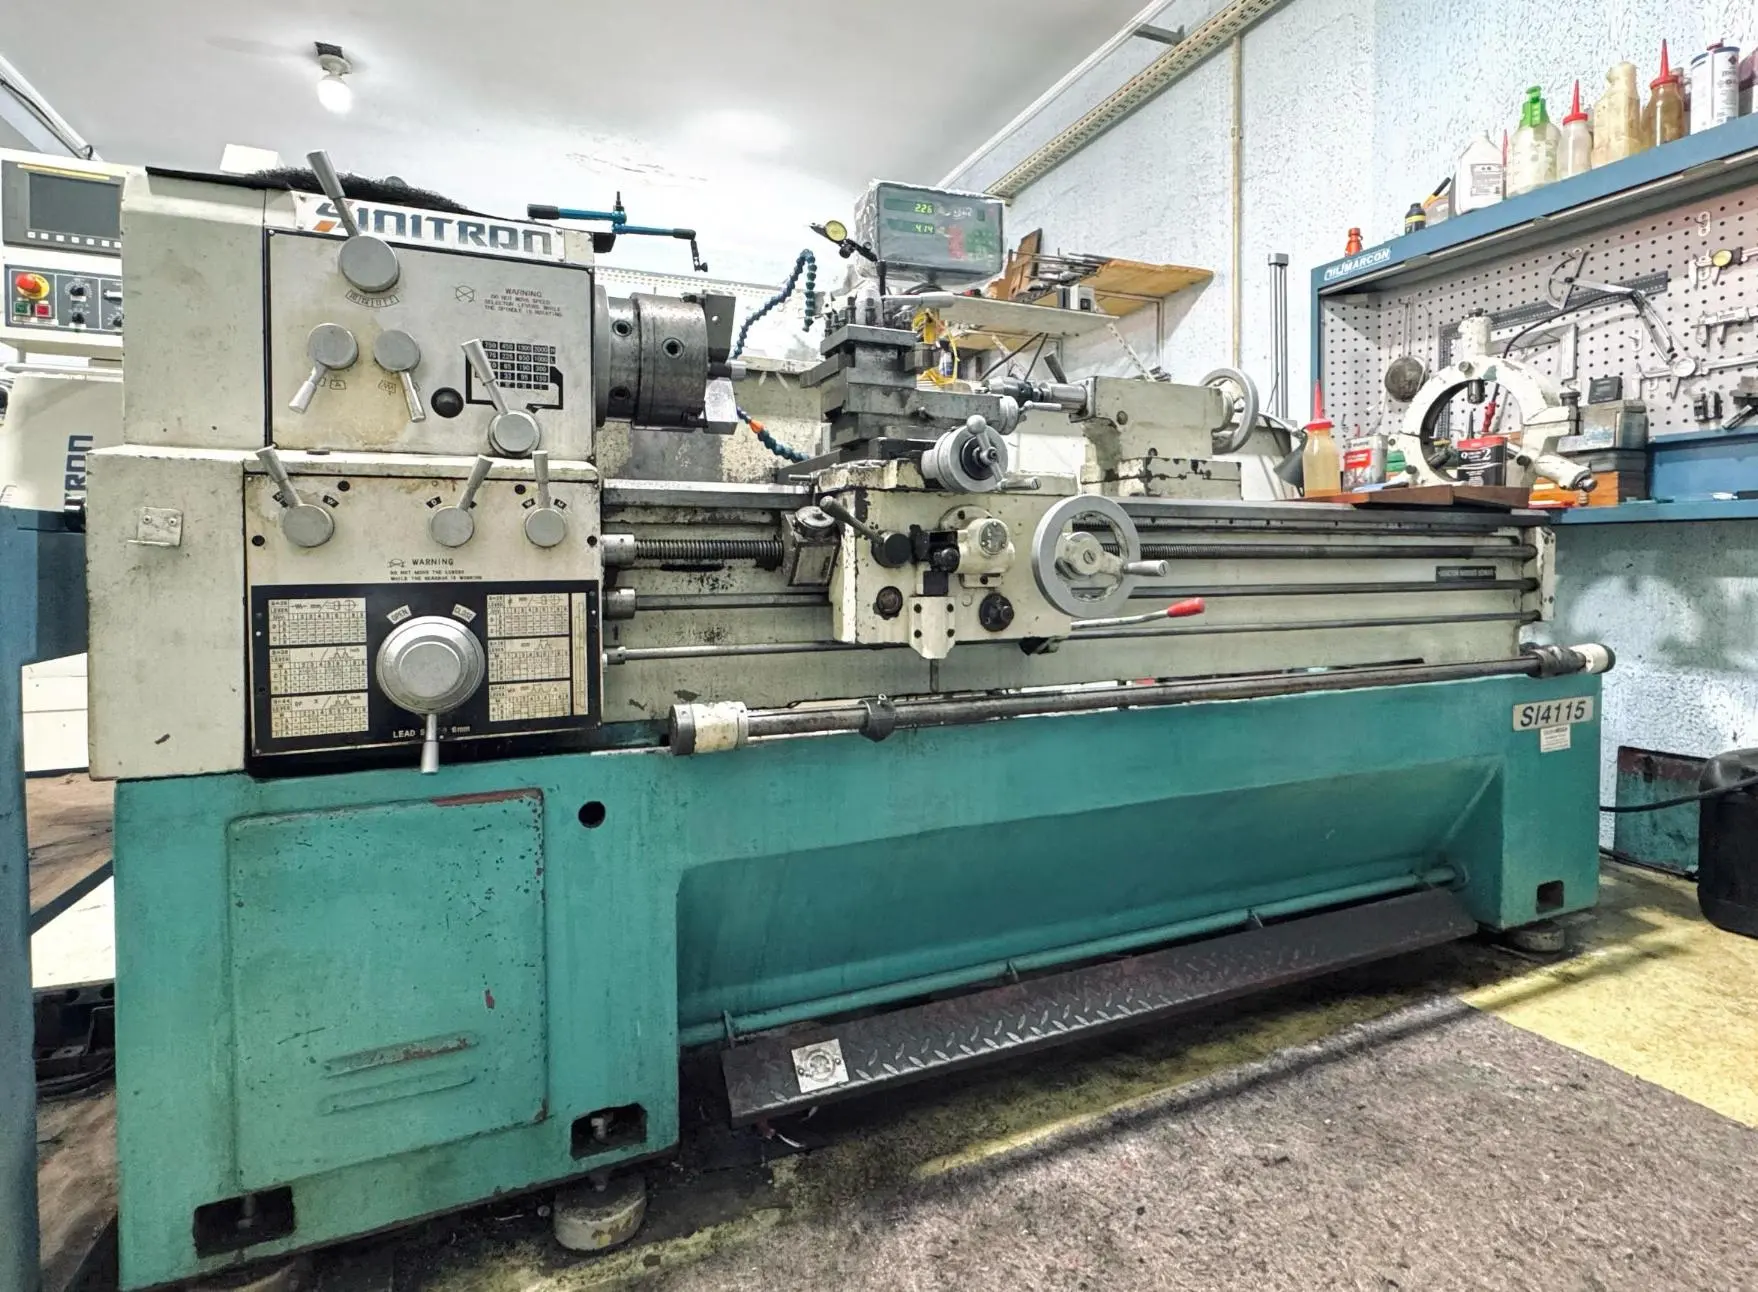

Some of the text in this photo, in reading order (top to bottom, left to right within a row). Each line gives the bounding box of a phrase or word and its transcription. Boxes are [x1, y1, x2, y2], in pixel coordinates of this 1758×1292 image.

[505, 288, 542, 297] WARNING
[412, 558, 454, 566] WARNING
[1520, 699, 1586, 727] SI4115
[392, 729, 416, 739] LEAD
